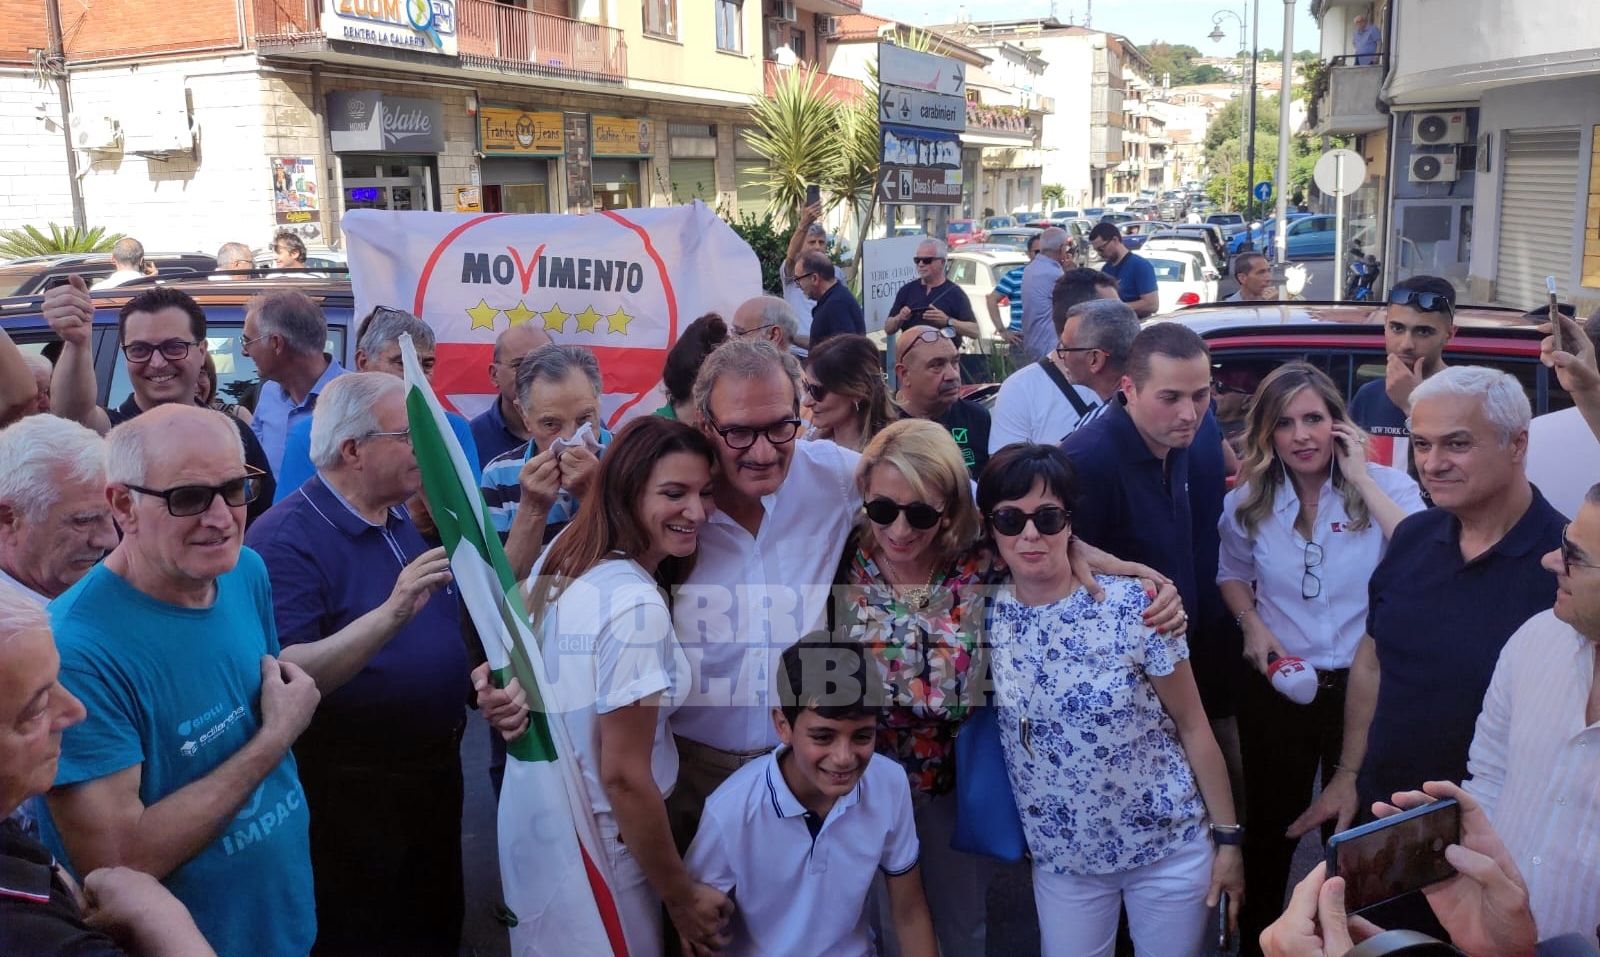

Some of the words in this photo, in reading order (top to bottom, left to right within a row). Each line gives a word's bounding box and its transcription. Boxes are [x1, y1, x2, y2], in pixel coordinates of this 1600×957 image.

[343, 26, 377, 42] DENTRO
[378, 33, 388, 43] LA
[382, 104, 432, 134] elatte
[920, 104, 956, 121] carabinieri
[537, 121, 561, 141] Jeans
[462, 243, 644, 294] MOVIMENTO
[222, 784, 300, 857] IMPAC
